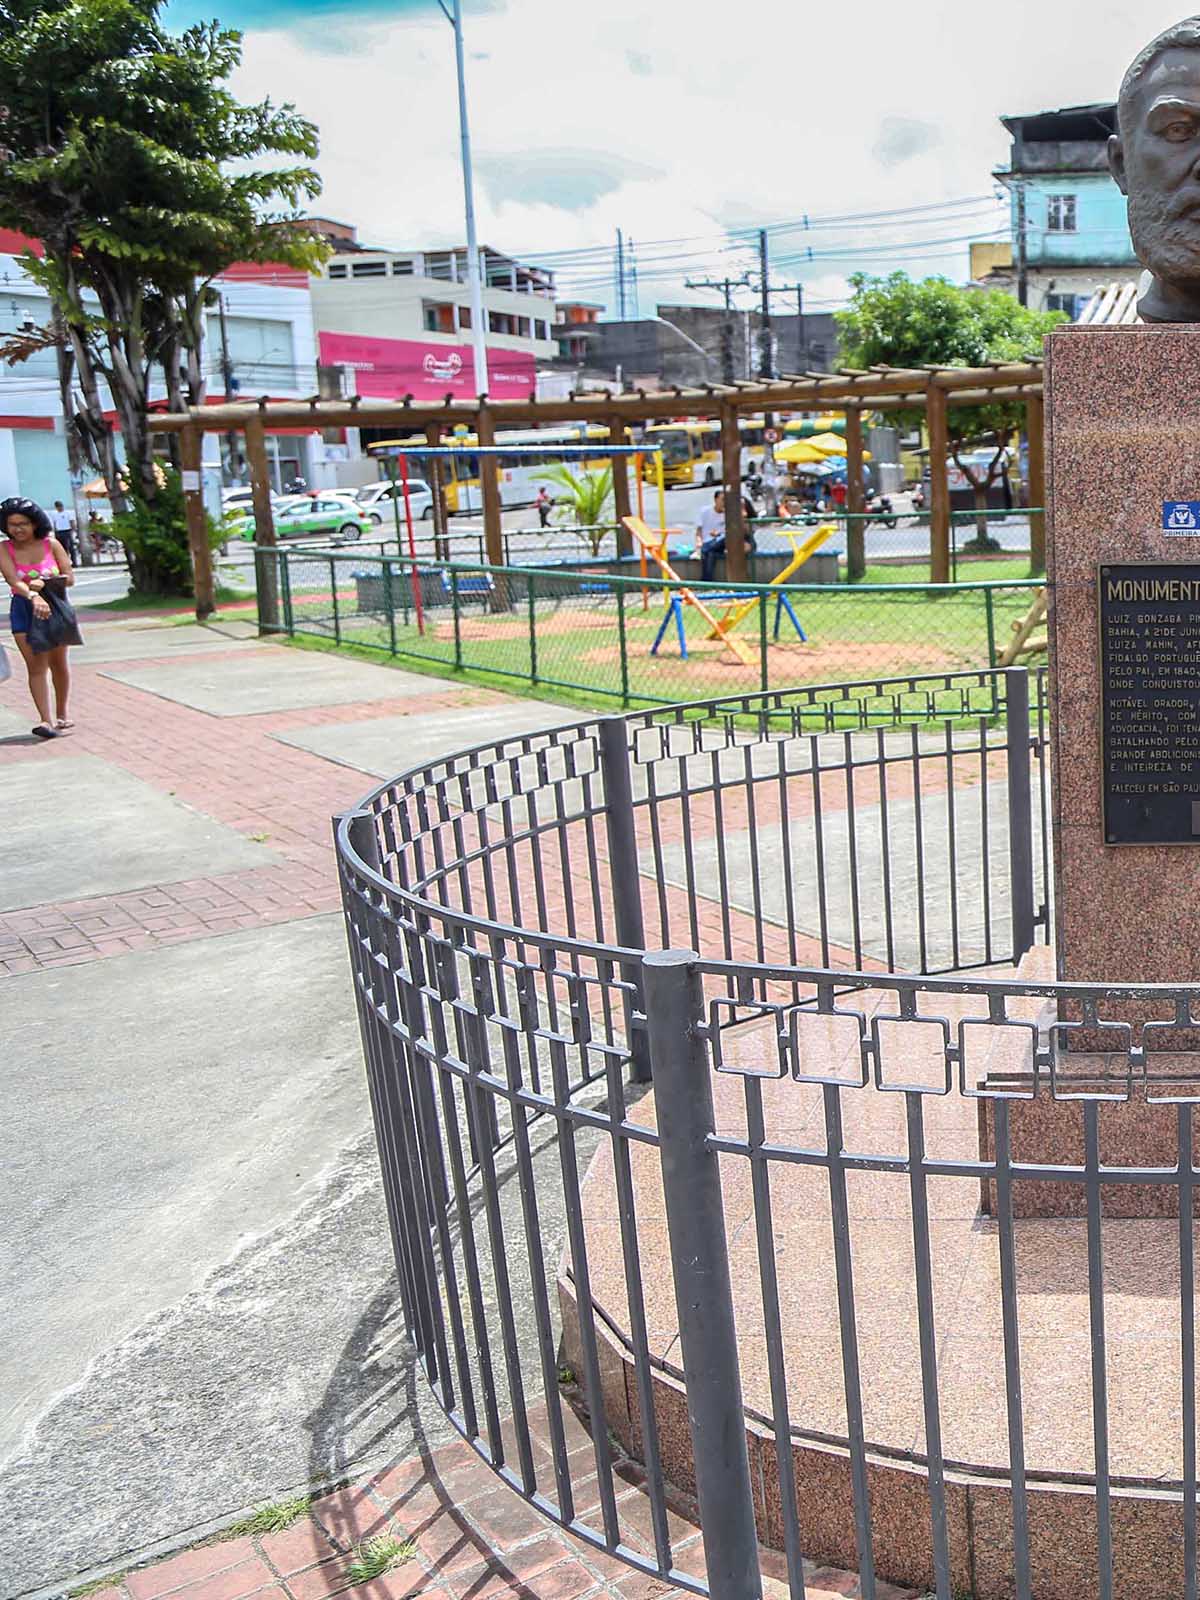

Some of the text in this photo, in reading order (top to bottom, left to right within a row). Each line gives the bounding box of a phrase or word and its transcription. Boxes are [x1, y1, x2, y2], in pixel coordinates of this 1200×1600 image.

[1108, 614, 1131, 623] LUIZ
[1137, 614, 1182, 623] GONZAGA
[1108, 627, 1140, 638] BAHIA,
[1144, 627, 1150, 636] A
[1109, 640, 1136, 649] LUIZA
[1109, 654, 1148, 663] FIDALGO
[1109, 666, 1132, 675] PELO
[1159, 666, 1170, 675] EM
[1174, 666, 1200, 677] 1840,
[1110, 680, 1135, 688] ONDE
[1143, 680, 1200, 688] CONQUISTOU
[1110, 696, 1148, 708] NOTÁVEL
[1154, 699, 1194, 709] ORADOR,
[1110, 712, 1123, 721] DE
[1178, 712, 1196, 721] COM
[1110, 725, 1162, 734] ADVOCACIA,
[1167, 725, 1179, 733] FOI
[1111, 738, 1169, 746] BATALHANDO
[1175, 738, 1198, 746] PELO
[1111, 751, 1146, 759] GRANDE
[1111, 763, 1117, 772] E
[1124, 763, 1172, 772] INTEIREZA
[1181, 763, 1193, 772] DE
[1111, 784, 1145, 793] FALECEU
[1149, 784, 1159, 793] EM
[1163, 782, 1180, 793] SÃO
